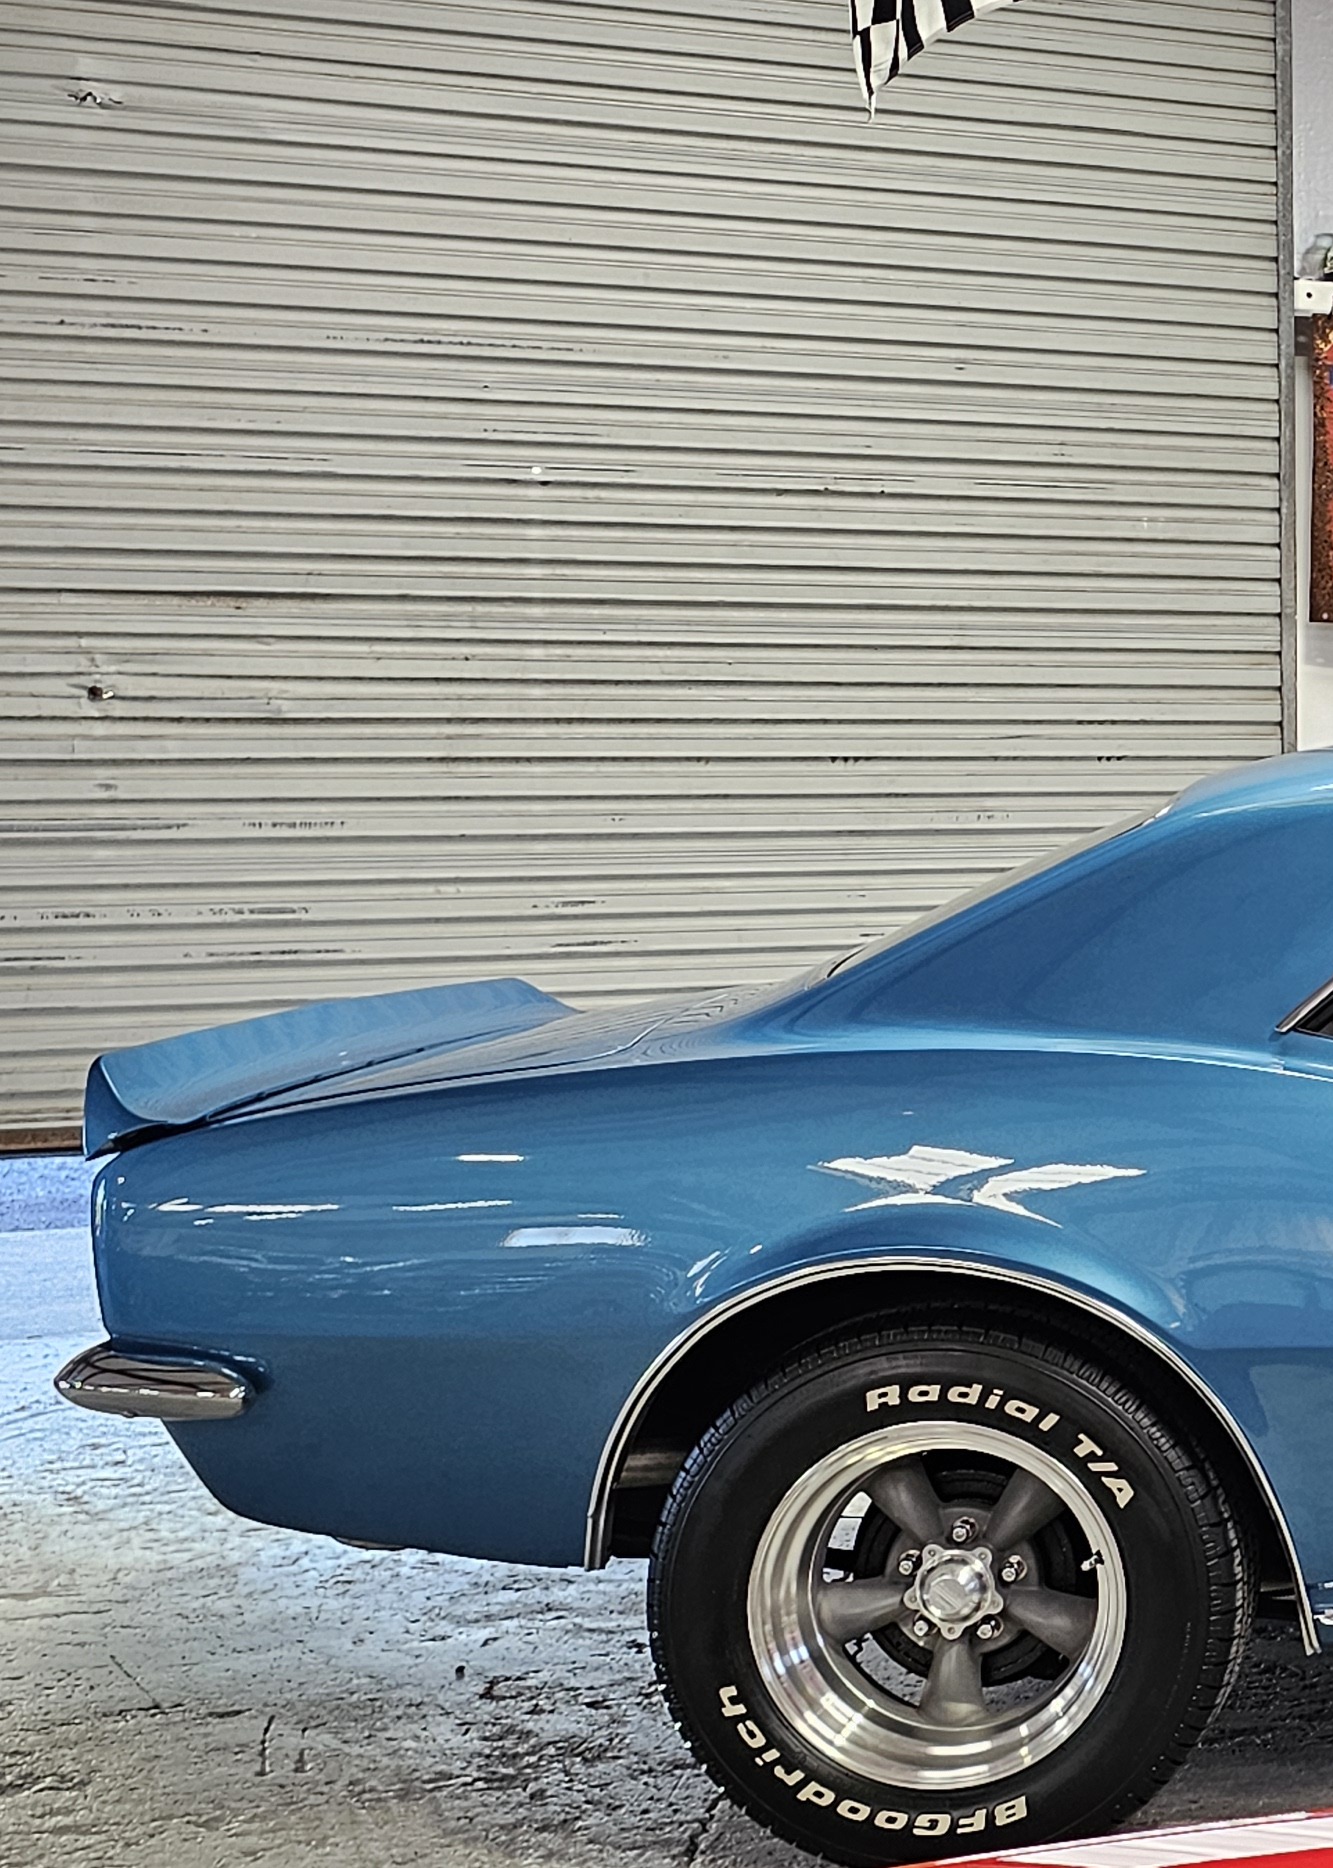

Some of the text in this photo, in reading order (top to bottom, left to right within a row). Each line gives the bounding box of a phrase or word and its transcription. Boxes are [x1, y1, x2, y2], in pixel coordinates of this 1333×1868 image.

[865, 1382, 1137, 1510] Radial T/A
[717, 1684, 1029, 1837] BFGoodrich
